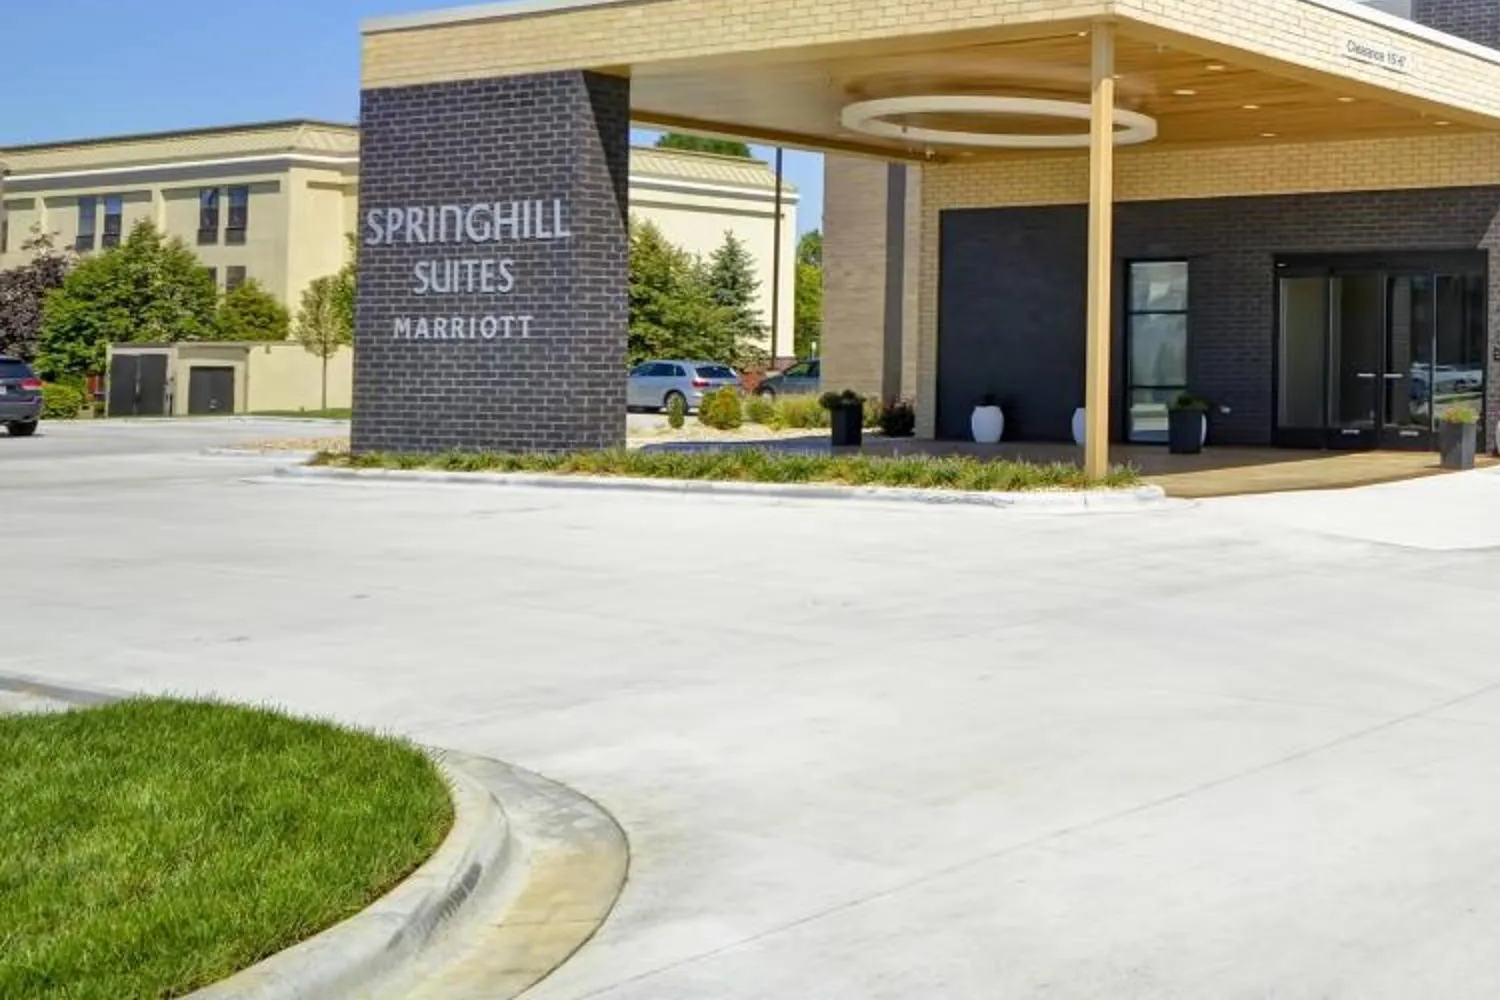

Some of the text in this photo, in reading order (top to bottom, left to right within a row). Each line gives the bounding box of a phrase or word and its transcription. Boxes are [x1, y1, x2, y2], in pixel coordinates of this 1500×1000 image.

[365, 199, 571, 246] SPRINGHILL
[413, 259, 515, 294] SUITES
[393, 315, 534, 340] MARRIOTT
